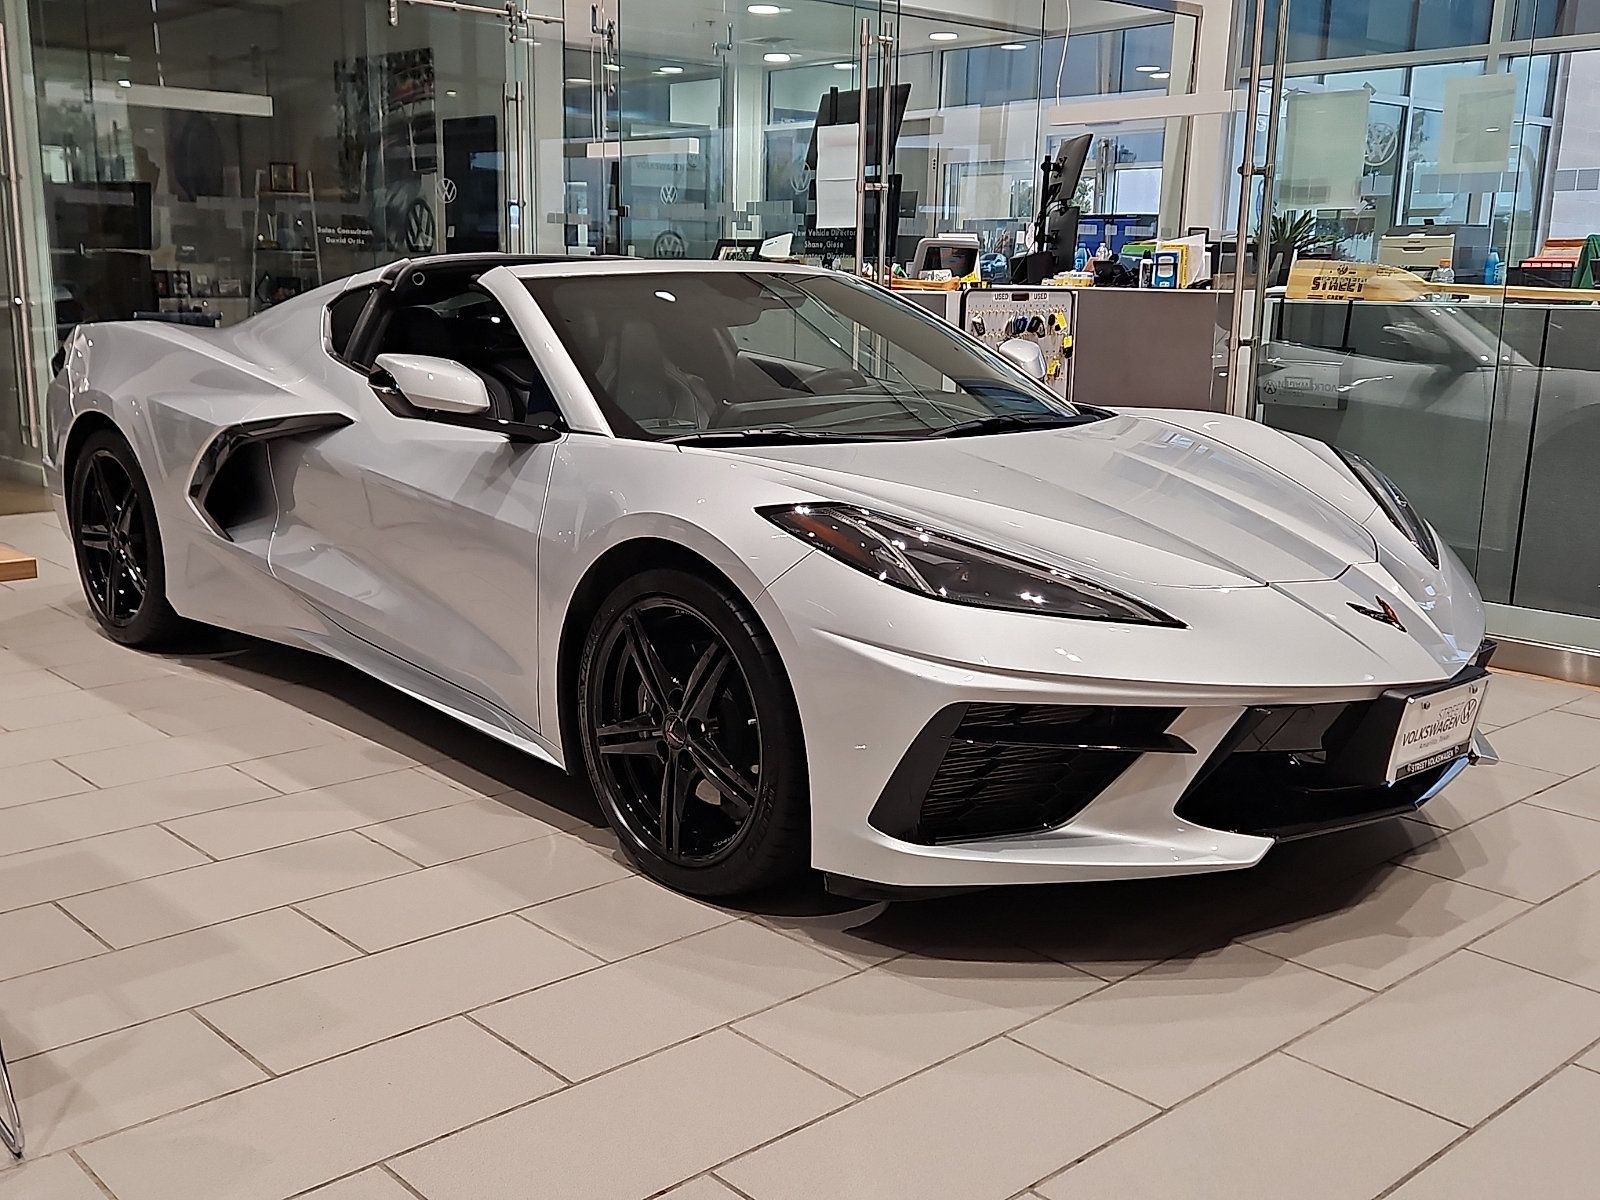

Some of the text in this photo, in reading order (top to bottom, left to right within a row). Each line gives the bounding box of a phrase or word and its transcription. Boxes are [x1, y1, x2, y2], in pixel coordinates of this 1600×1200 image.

[808, 228, 830, 237] Vehicle
[830, 228, 857, 237] Director
[804, 240, 824, 249] Shane
[1310, 275, 1366, 293] STREET
[994, 292, 1009, 300] USED
[1033, 292, 1048, 300] USED
[1402, 714, 1461, 746] VOLKSWAGEN
[1411, 749, 1454, 773] STREET VOLKSWAGEN
